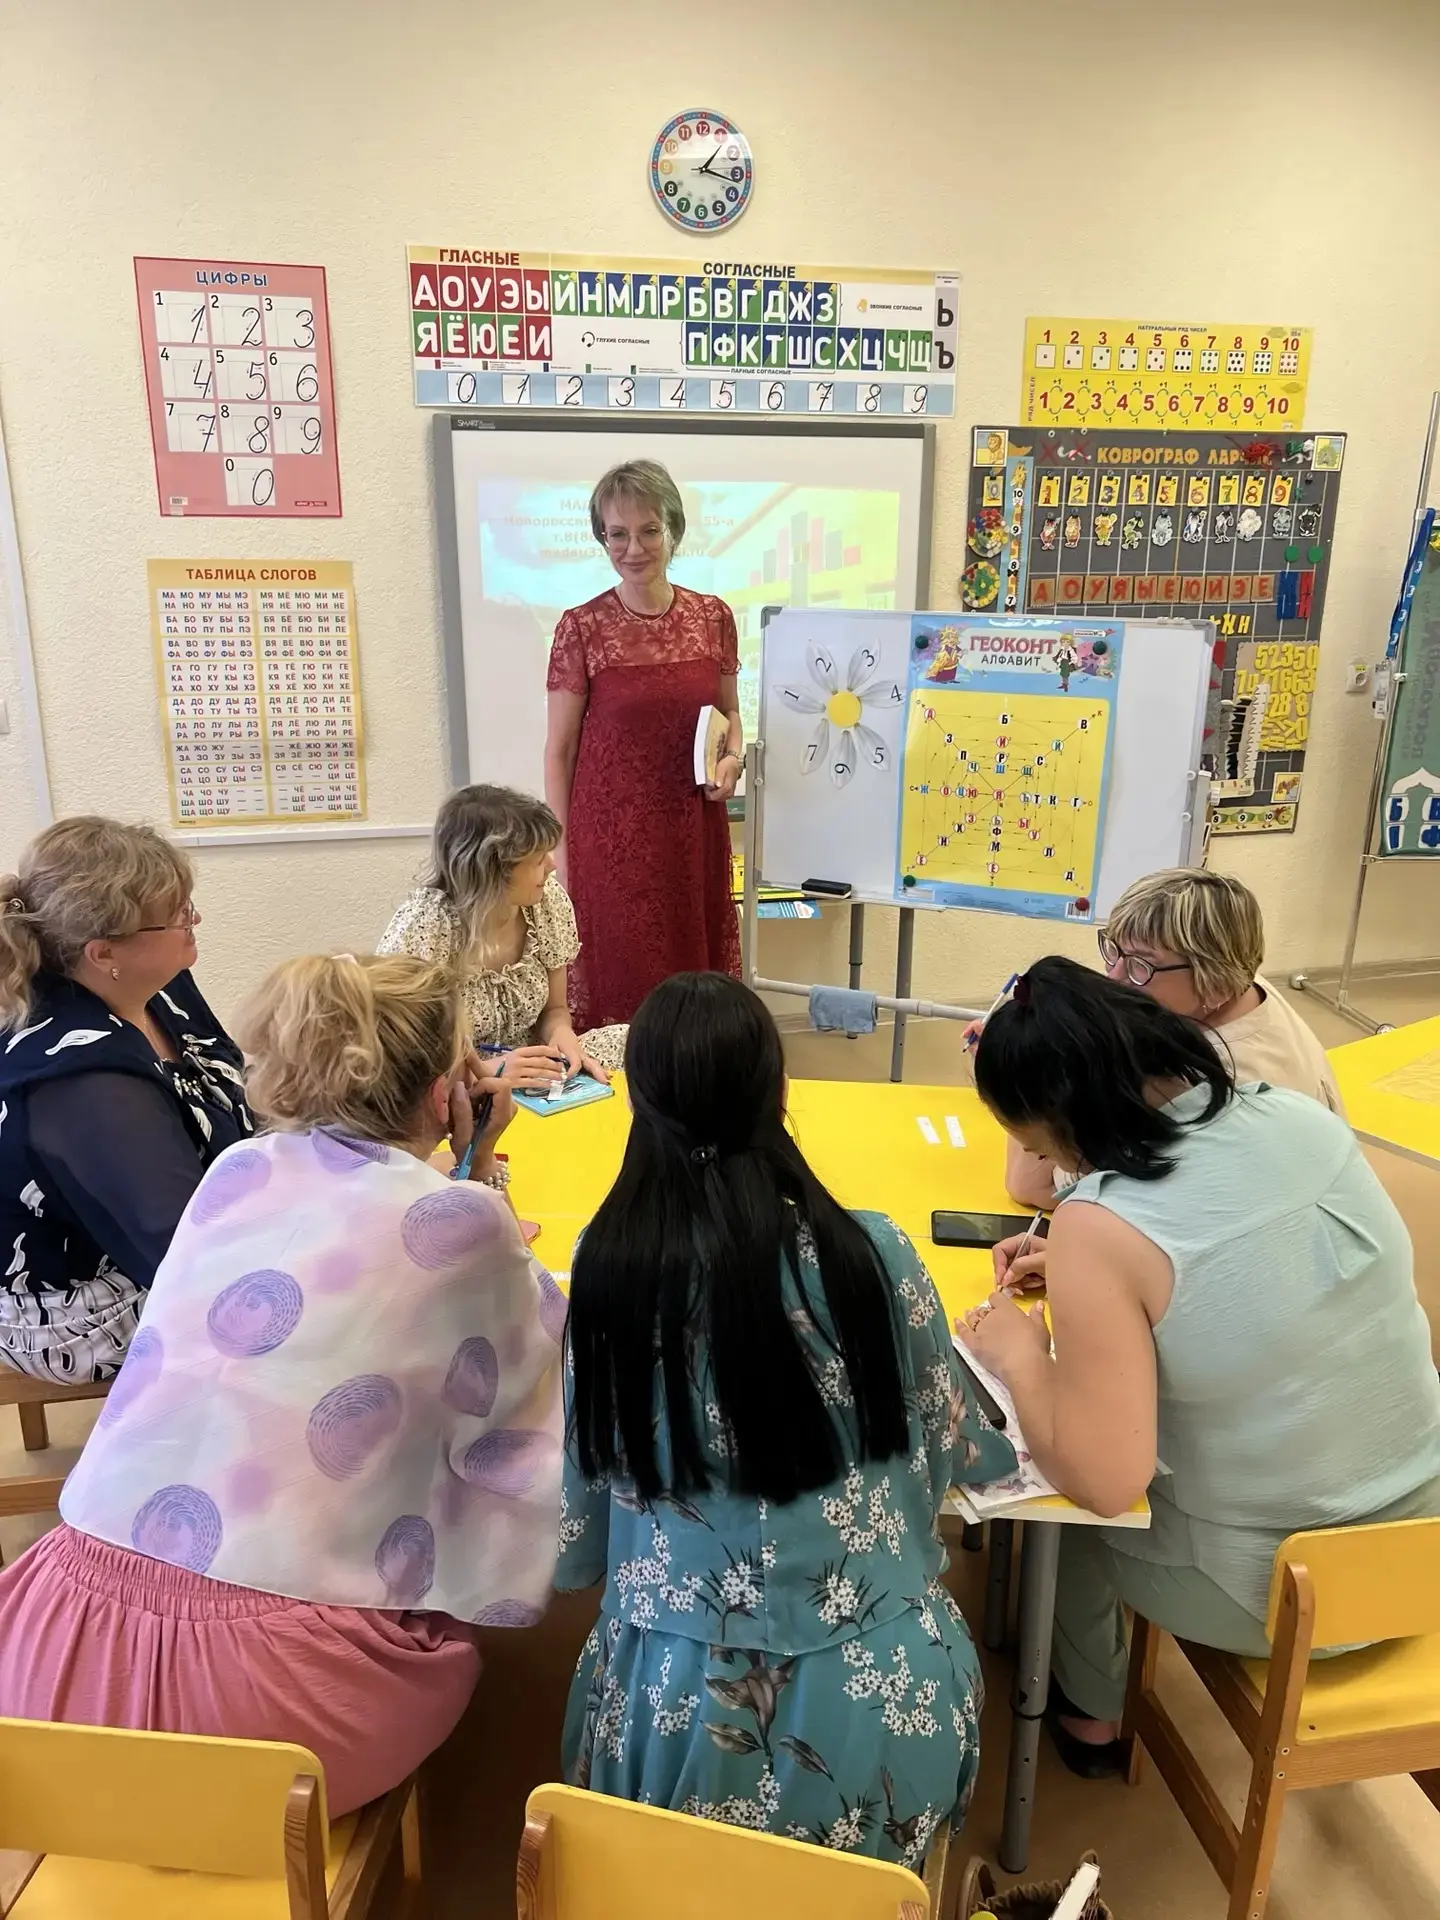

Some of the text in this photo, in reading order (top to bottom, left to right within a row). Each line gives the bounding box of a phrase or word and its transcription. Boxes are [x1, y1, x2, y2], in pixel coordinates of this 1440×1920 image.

[680, 128, 690, 137] 11
[697, 123, 708, 134] 12
[667, 142, 677, 152] 10
[731, 148, 737, 157] 2
[734, 170, 740, 179] 3
[668, 185, 674, 194] 8
[729, 190, 735, 199] 4
[681, 201, 687, 210] 7
[698, 208, 705, 217] 6
[715, 203, 722, 213] 5
[439, 249, 520, 266] ГЛАСНЫЕ
[195, 270, 268, 287] ЦИФРЫ
[703, 262, 796, 279] СОГЛАСНЫЕ
[155, 292, 164, 306] 1
[211, 295, 219, 309] 2
[265, 298, 273, 311] 3
[937, 298, 954, 327] Ь
[191, 305, 205, 343] 1
[242, 307, 263, 346] 2
[294, 310, 315, 348] 3
[1043, 330, 1300, 351] 1 2 3 4 5 6 7 8 9 10
[160, 347, 169, 361] 4
[216, 350, 224, 363] 5
[269, 352, 277, 366] 6
[935, 341, 954, 369] Ъ
[194, 359, 212, 399] 4
[246, 362, 266, 400] 5
[296, 363, 318, 402] 6
[458, 372, 927, 413] 0 1 2 3 4 5 6 7 8 9
[166, 402, 174, 416] 7
[1039, 392, 1288, 414] 1 2 3 4 5 6 7 8 9 10
[220, 405, 229, 418] 8
[274, 407, 282, 420] 9
[197, 414, 216, 452] 7
[248, 416, 269, 453] 8
[300, 417, 321, 454] 9
[1097, 447, 1199, 464] КОВРОГРАФ
[225, 458, 234, 471] 0
[252, 469, 274, 506] 0
[186, 568, 317, 582] ТАБЛИЦА СЛОГОВ
[1035, 582, 1047, 602] А
[1064, 579, 1079, 598] О
[969, 635, 1057, 654] ГЕОКОНТ
[815, 657, 832, 673] 2
[862, 649, 875, 667] 3
[981, 654, 1041, 667] АЛФАВИТ
[784, 690, 799, 701] 1
[891, 684, 902, 702] 4
[808, 745, 817, 761] 7
[873, 747, 884, 764] 5
